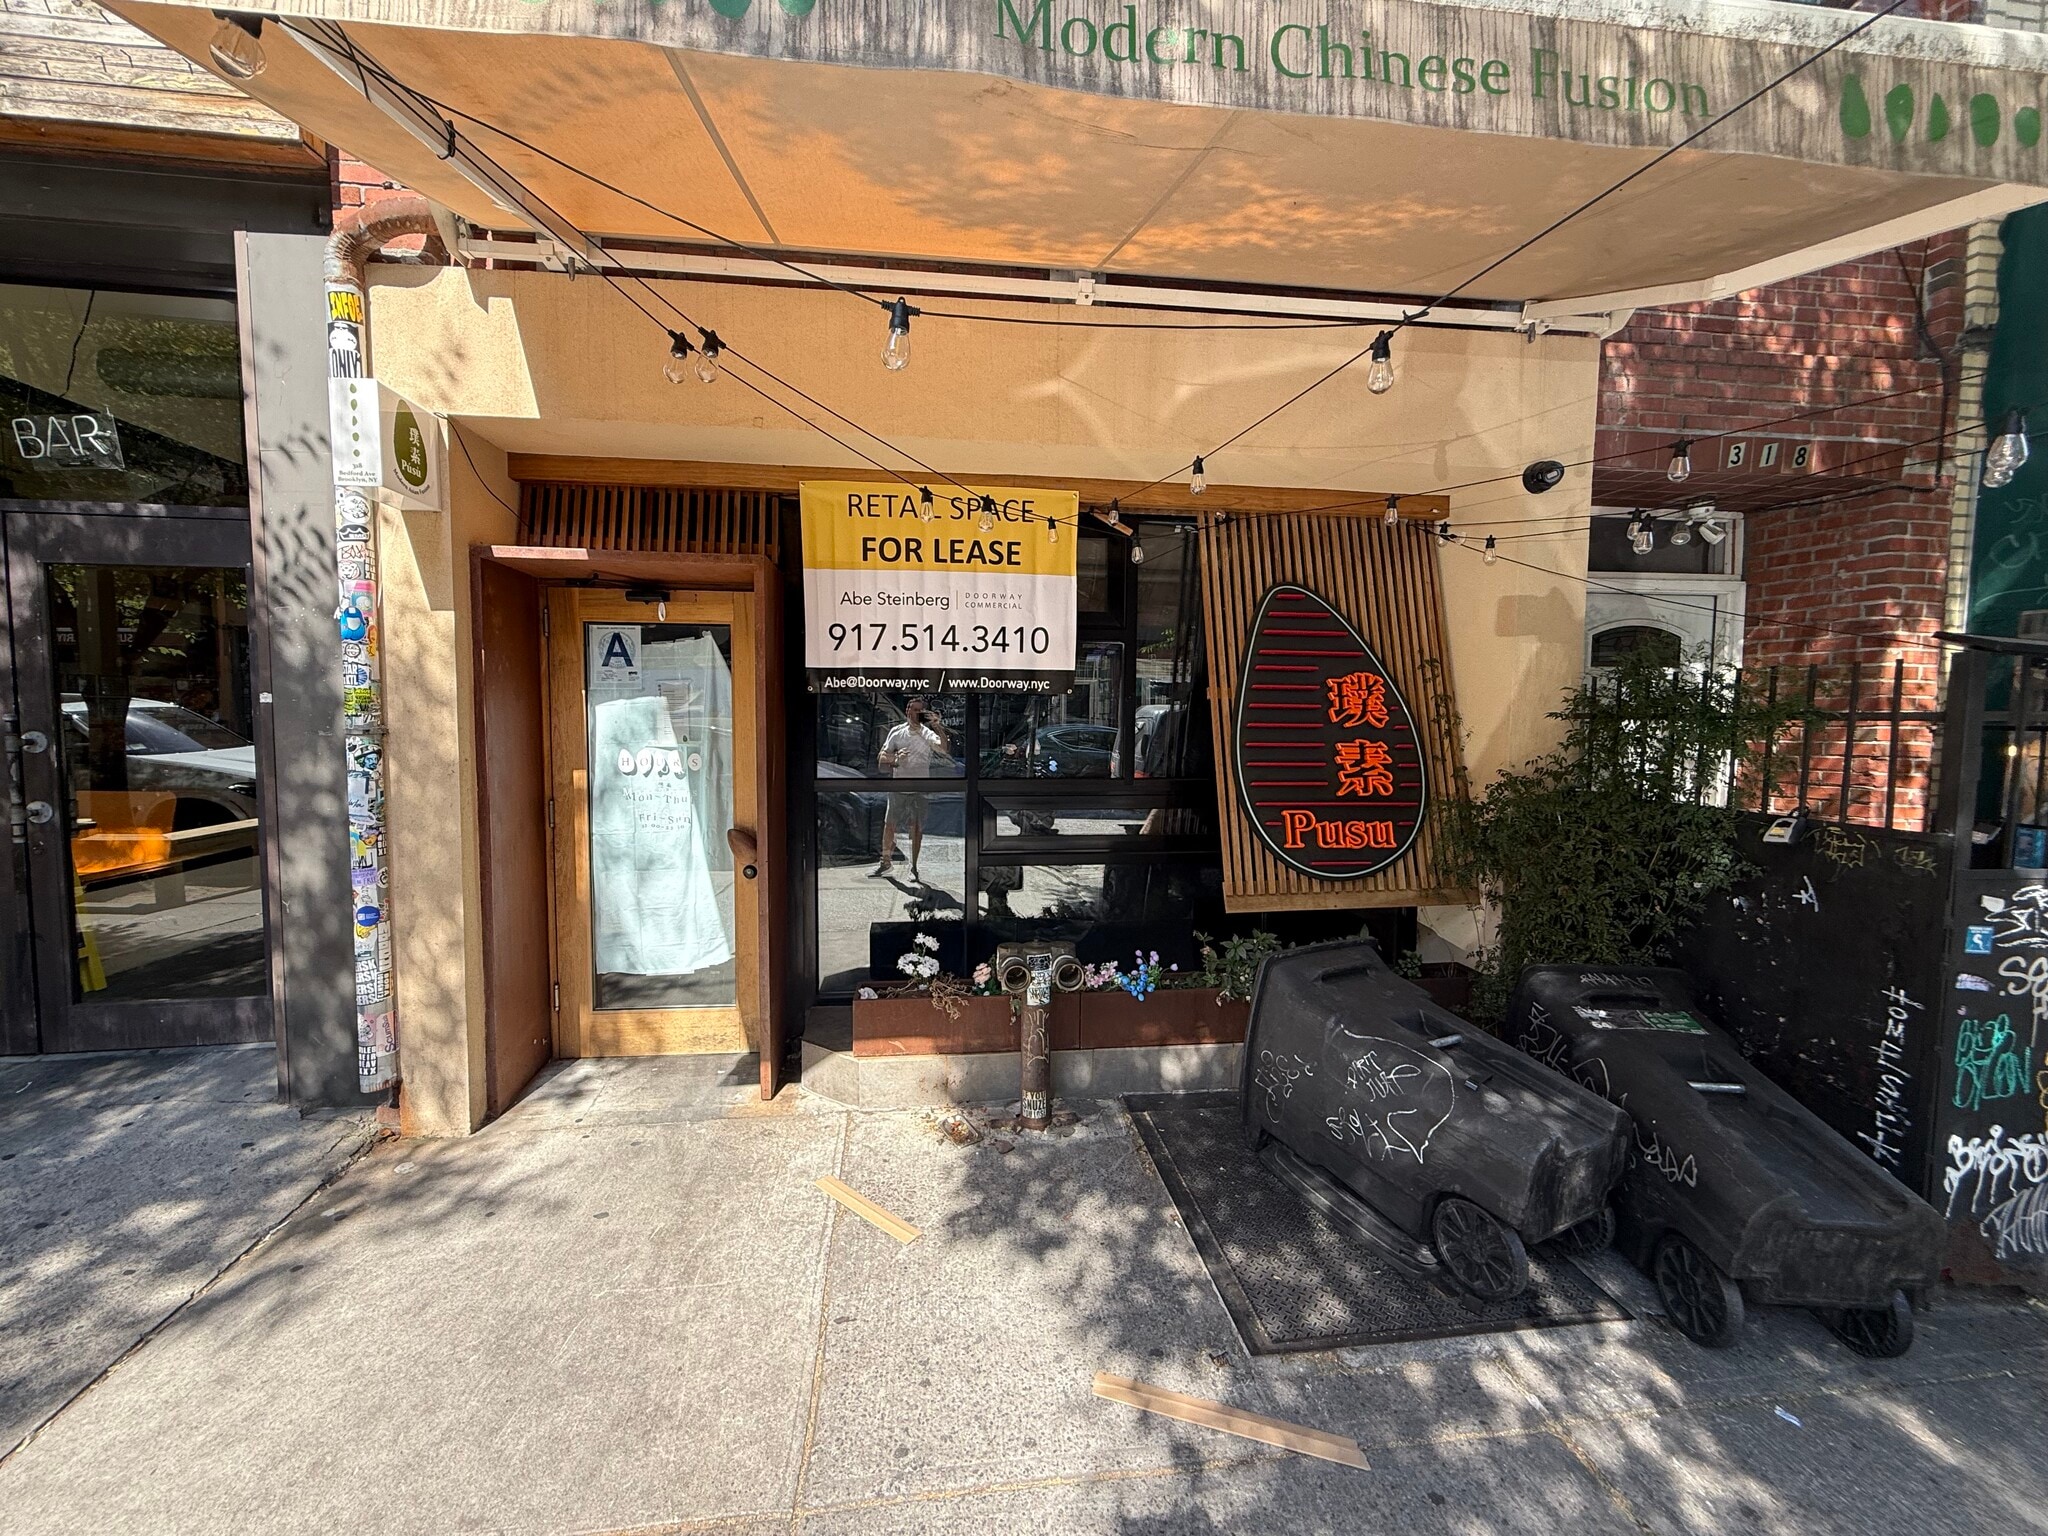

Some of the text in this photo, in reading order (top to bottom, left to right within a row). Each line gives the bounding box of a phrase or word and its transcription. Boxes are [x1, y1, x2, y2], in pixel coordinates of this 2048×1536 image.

[993, 0, 1715, 117] Modern Chinese Fusion
[12, 415, 109, 458] BAR
[862, 537, 1022, 566] FOR LEASE
[840, 591, 950, 611] Abe Steinberg
[964, 601, 1023, 610] COMMERCIAL
[965, 592, 1024, 601] DOORWAY
[601, 632, 634, 667] A
[828, 622, 1050, 655] 917.514.3410
[824, 675, 930, 690] Abe@Doorway.nyc
[948, 676, 1050, 691] www.Doorway.nyc
[1281, 810, 1397, 849] Pusu
